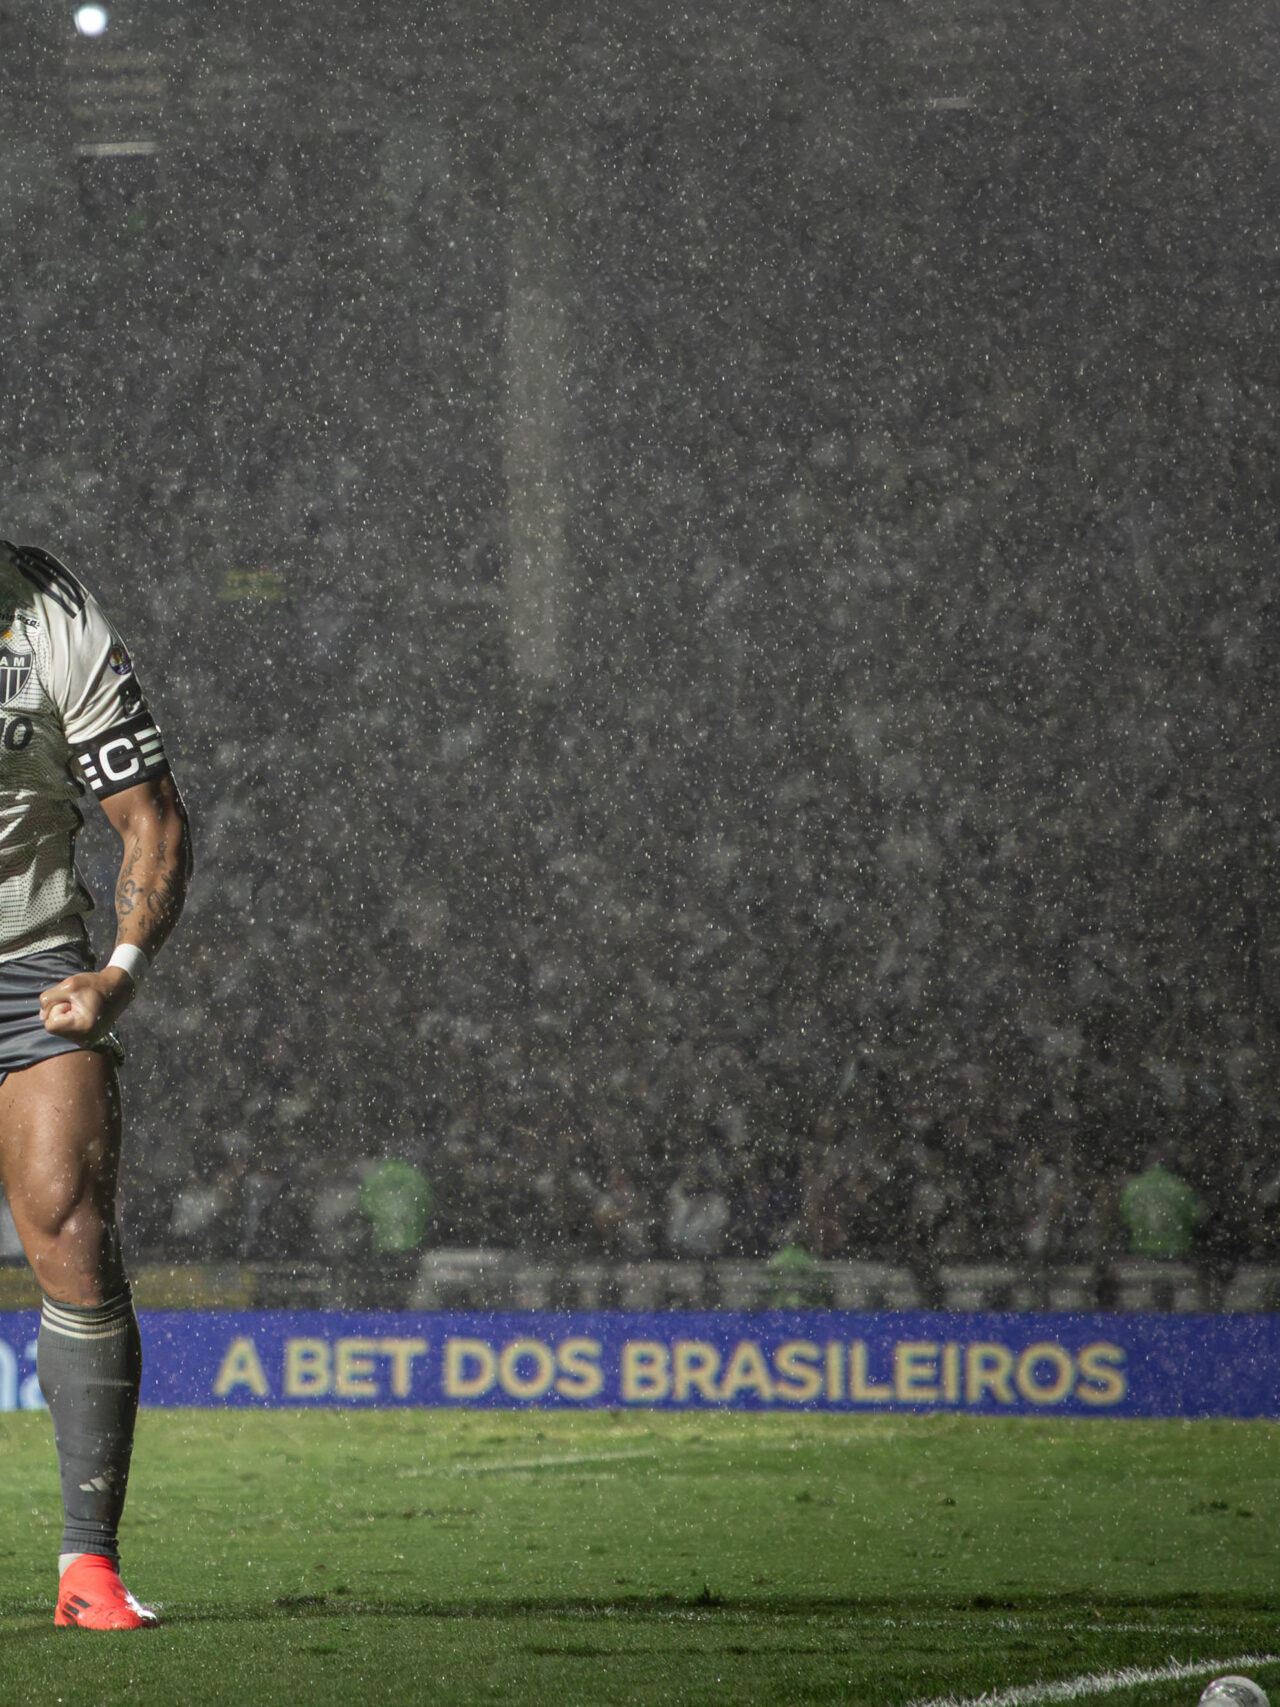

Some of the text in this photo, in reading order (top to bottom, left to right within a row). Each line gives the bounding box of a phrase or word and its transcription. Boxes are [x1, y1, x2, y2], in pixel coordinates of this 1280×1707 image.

[98, 737, 140, 782] C
[213, 1334, 1126, 1405] A BET DOS BRASILEIROS
